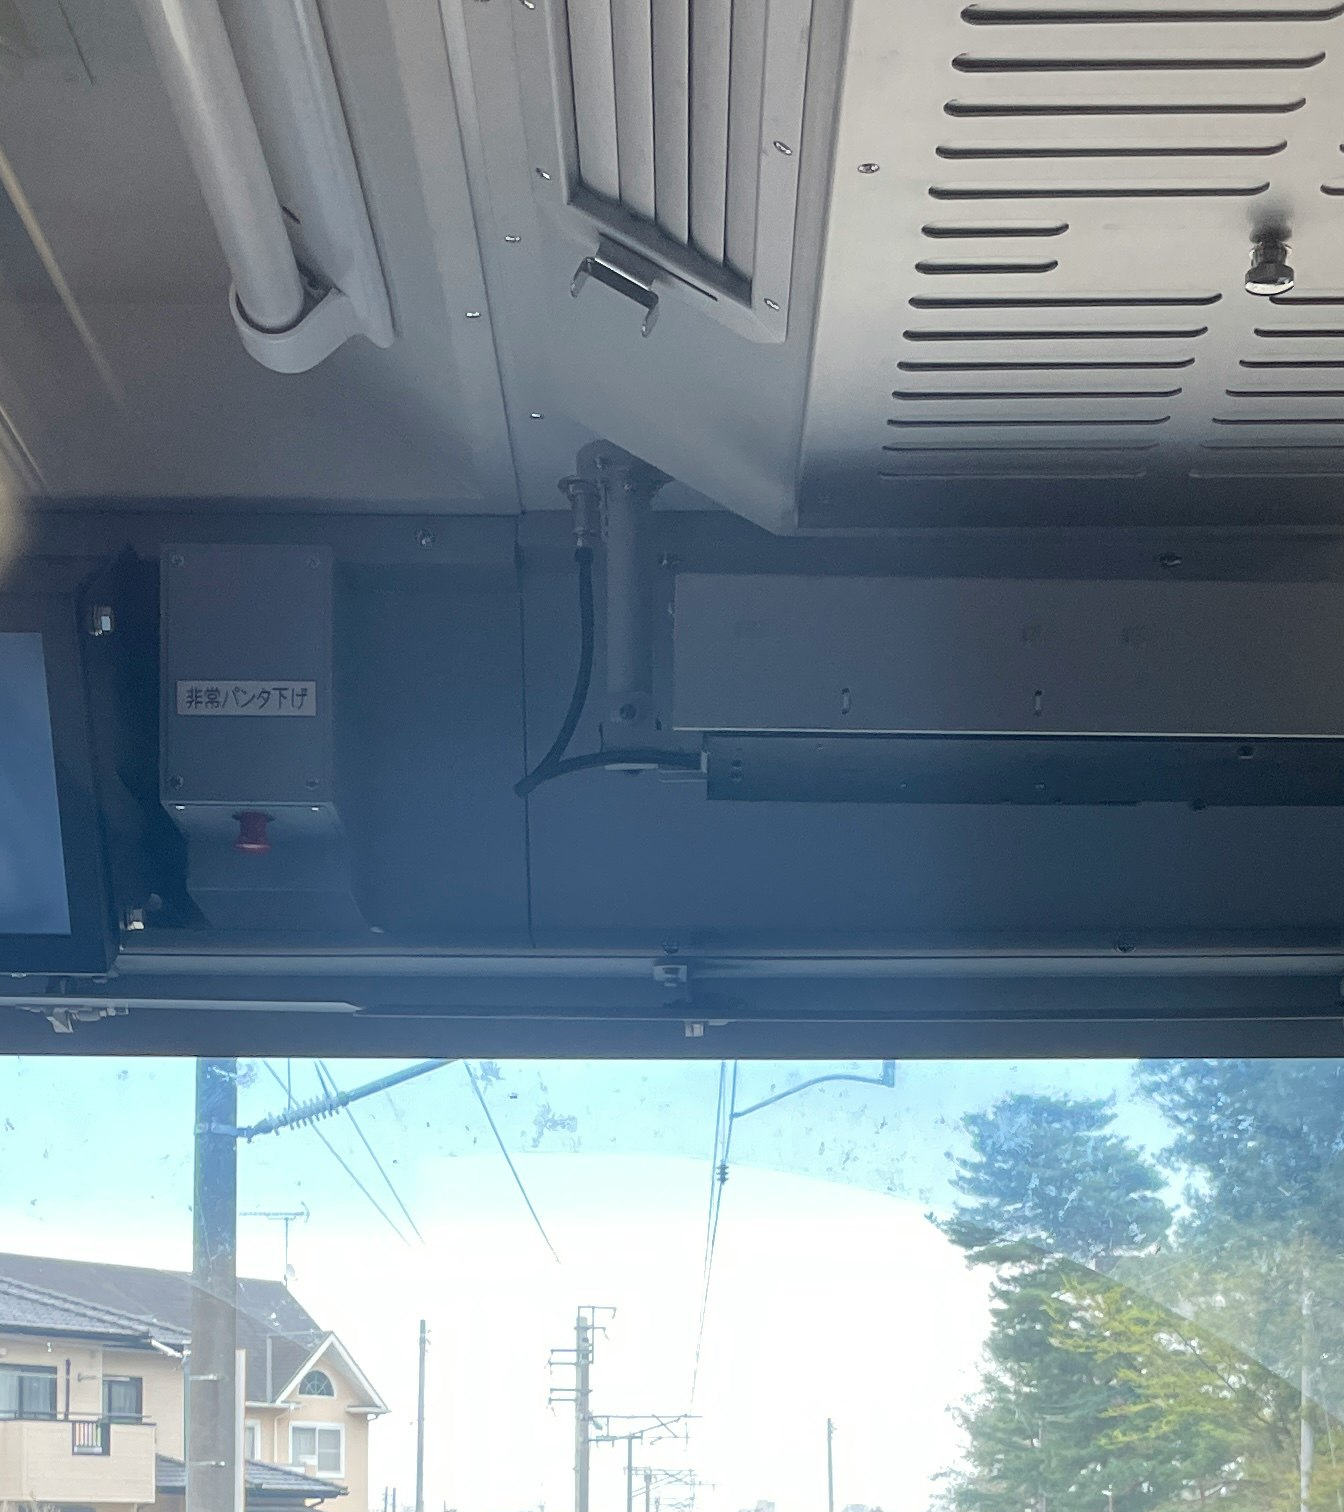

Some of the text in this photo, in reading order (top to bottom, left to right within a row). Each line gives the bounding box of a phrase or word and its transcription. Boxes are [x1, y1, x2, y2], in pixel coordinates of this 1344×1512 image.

[185, 686, 309, 710] 非常パンタ下げ
